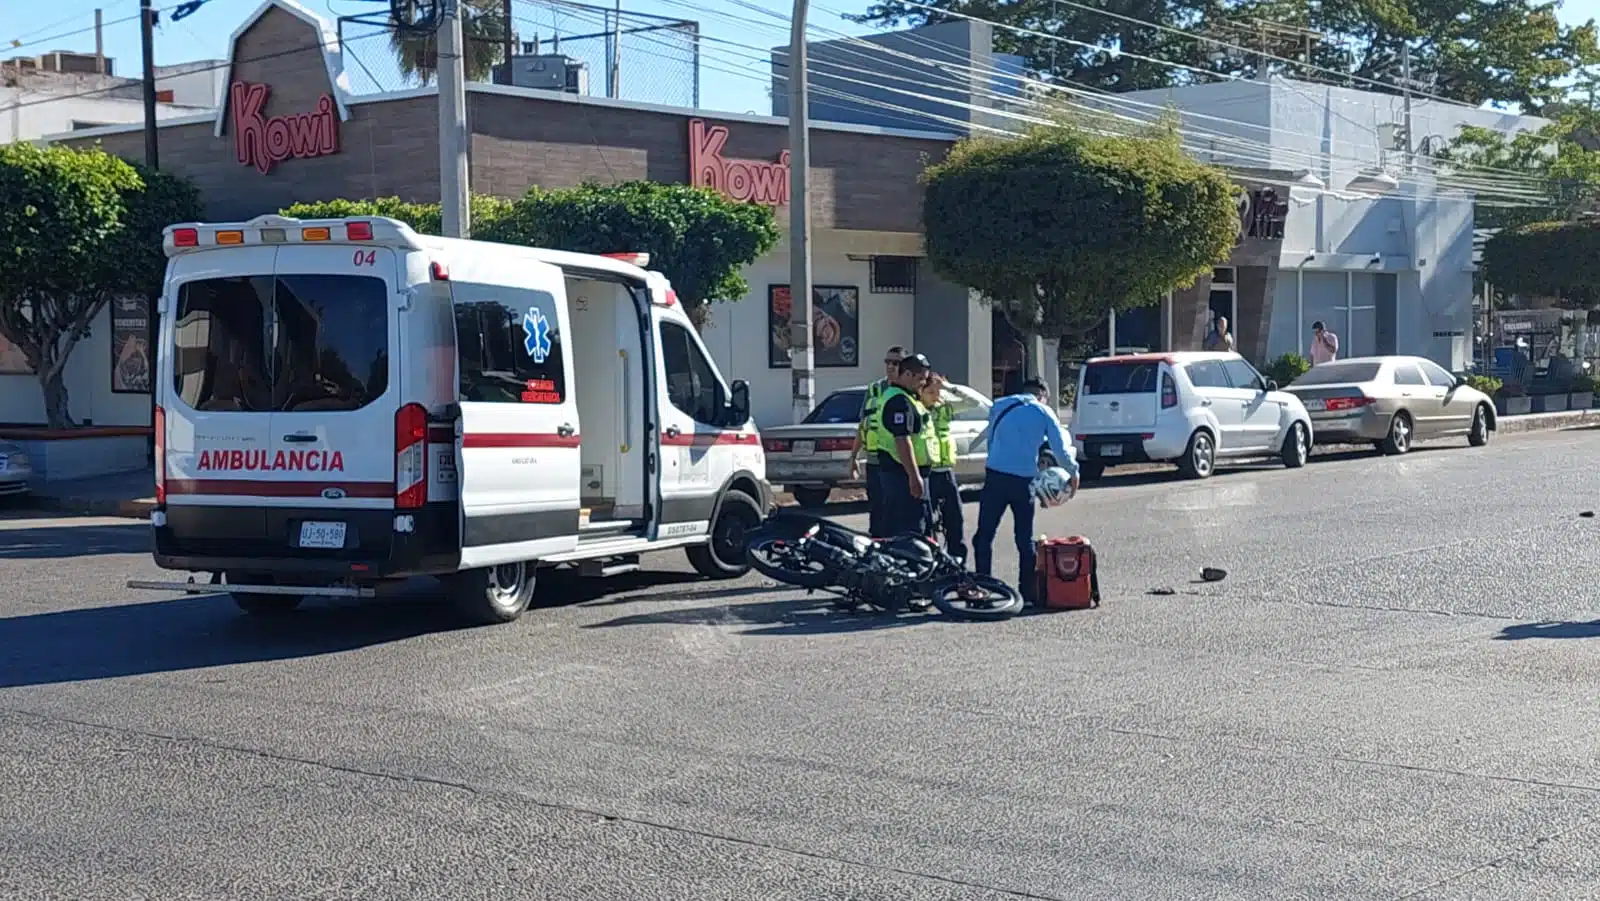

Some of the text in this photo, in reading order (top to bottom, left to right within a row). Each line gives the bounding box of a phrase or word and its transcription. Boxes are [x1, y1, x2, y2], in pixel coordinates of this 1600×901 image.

[231, 80, 340, 175] Kowi
[353, 249, 376, 267] 04
[197, 449, 344, 472] AMBULANCIA
